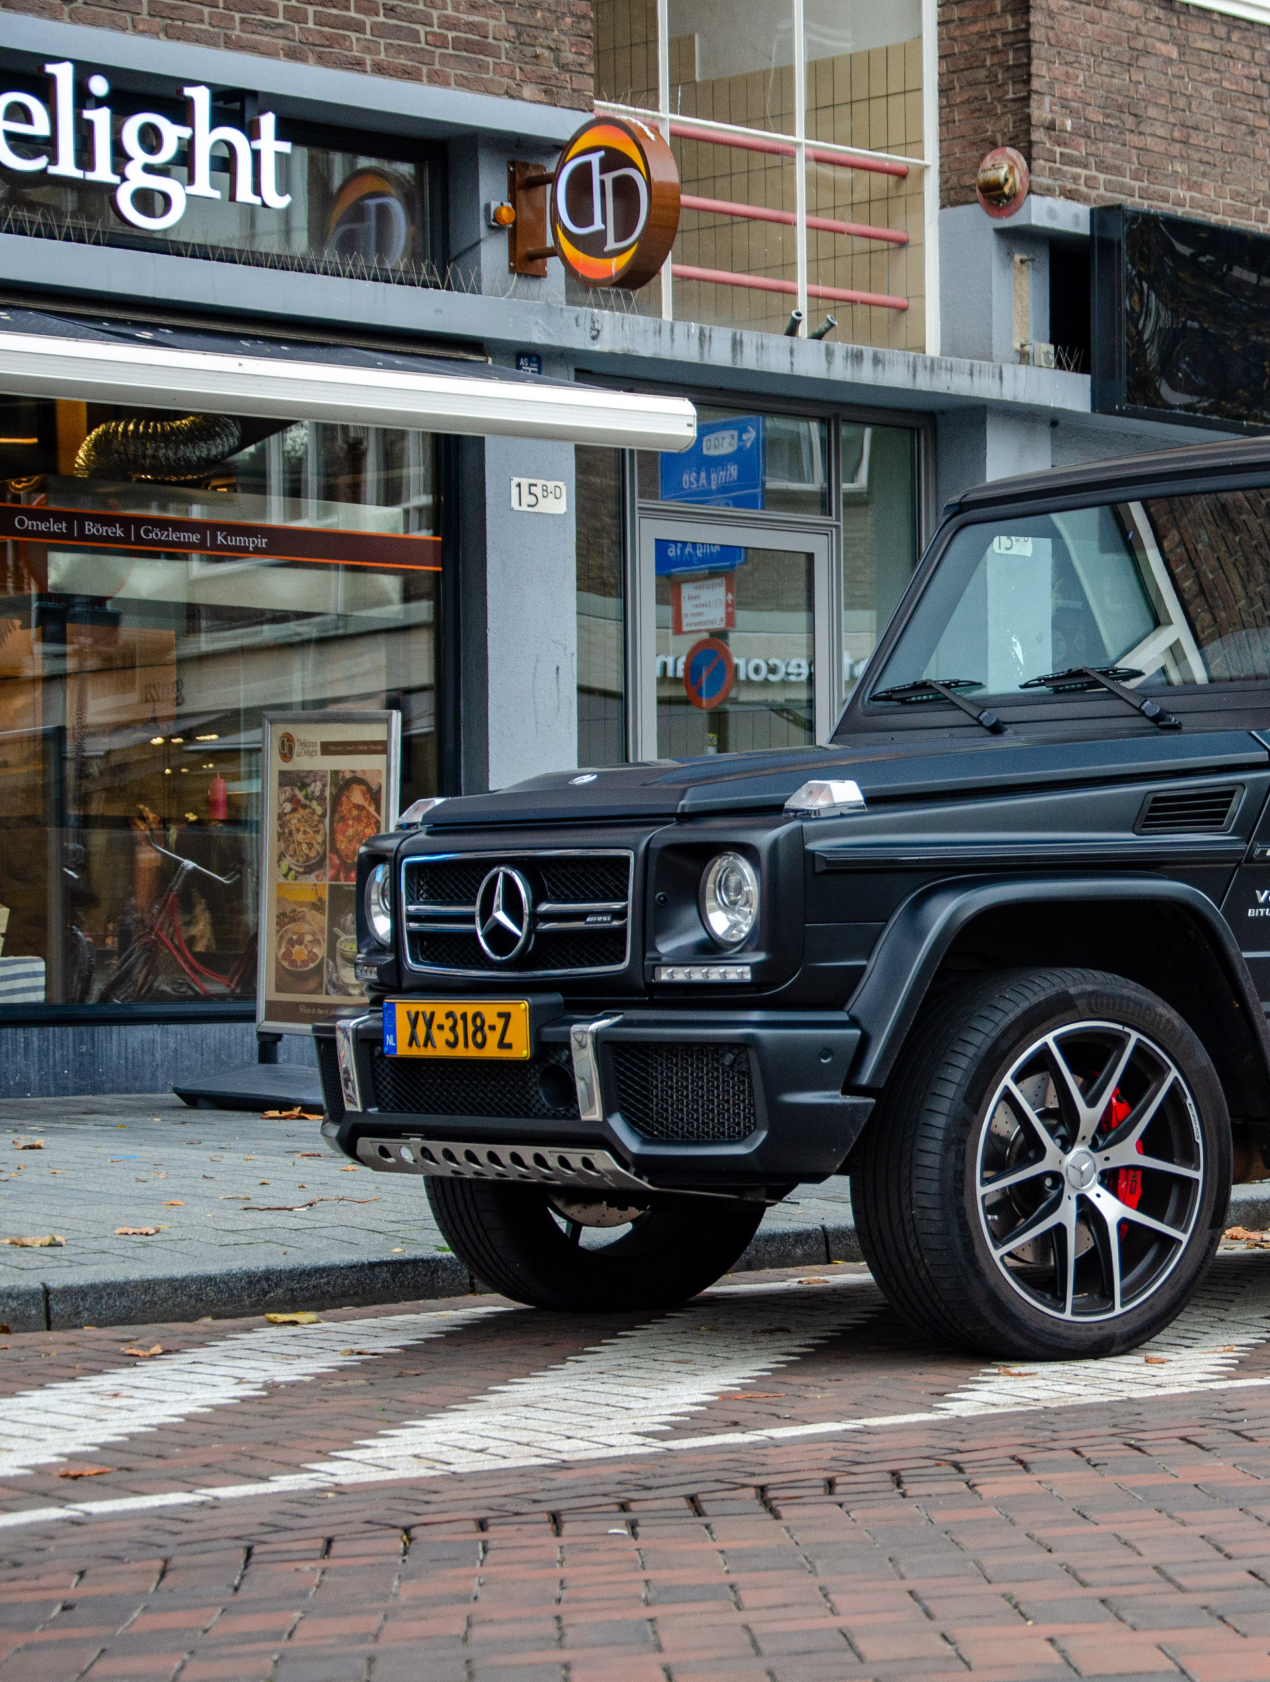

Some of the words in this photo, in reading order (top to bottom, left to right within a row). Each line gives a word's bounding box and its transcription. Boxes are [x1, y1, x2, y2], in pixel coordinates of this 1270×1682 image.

[0, 61, 292, 231] elight
[14, 515, 67, 533] Omelet
[84, 521, 125, 538] Börek
[140, 525, 201, 544] Gözleme
[216, 531, 268, 551] Kumpir
[386, 1034, 396, 1046] NL
[406, 1010, 513, 1050] XX-318-Z
